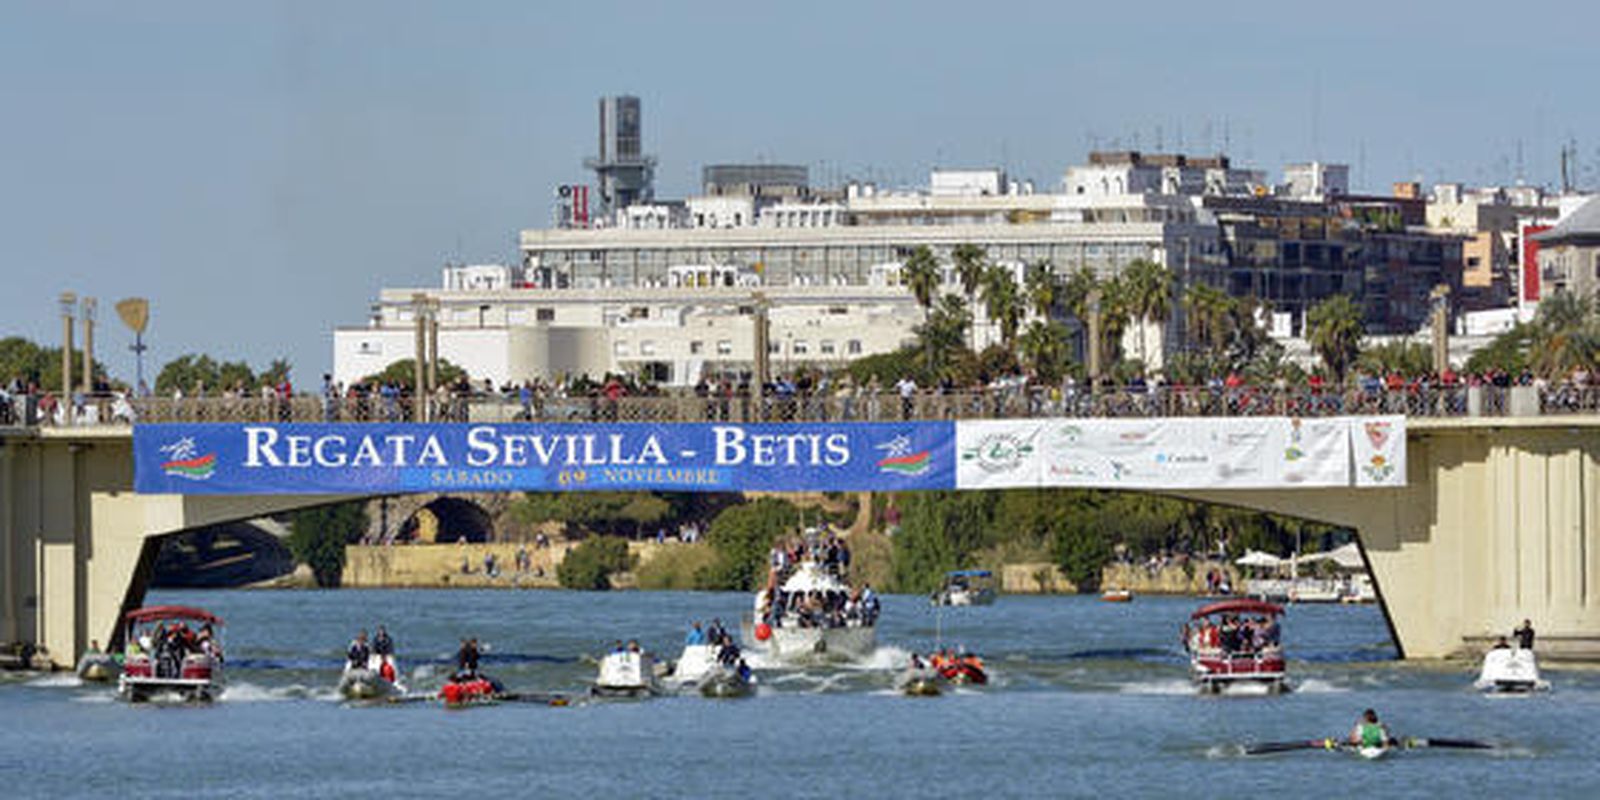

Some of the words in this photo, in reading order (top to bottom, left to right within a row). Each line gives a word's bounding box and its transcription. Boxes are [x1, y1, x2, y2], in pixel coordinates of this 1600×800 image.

[242, 426, 449, 468] REGATA
[466, 425, 668, 467] SEVILLA
[712, 425, 850, 467] BETIS
[603, 468, 720, 485] NOVIEMBRE
